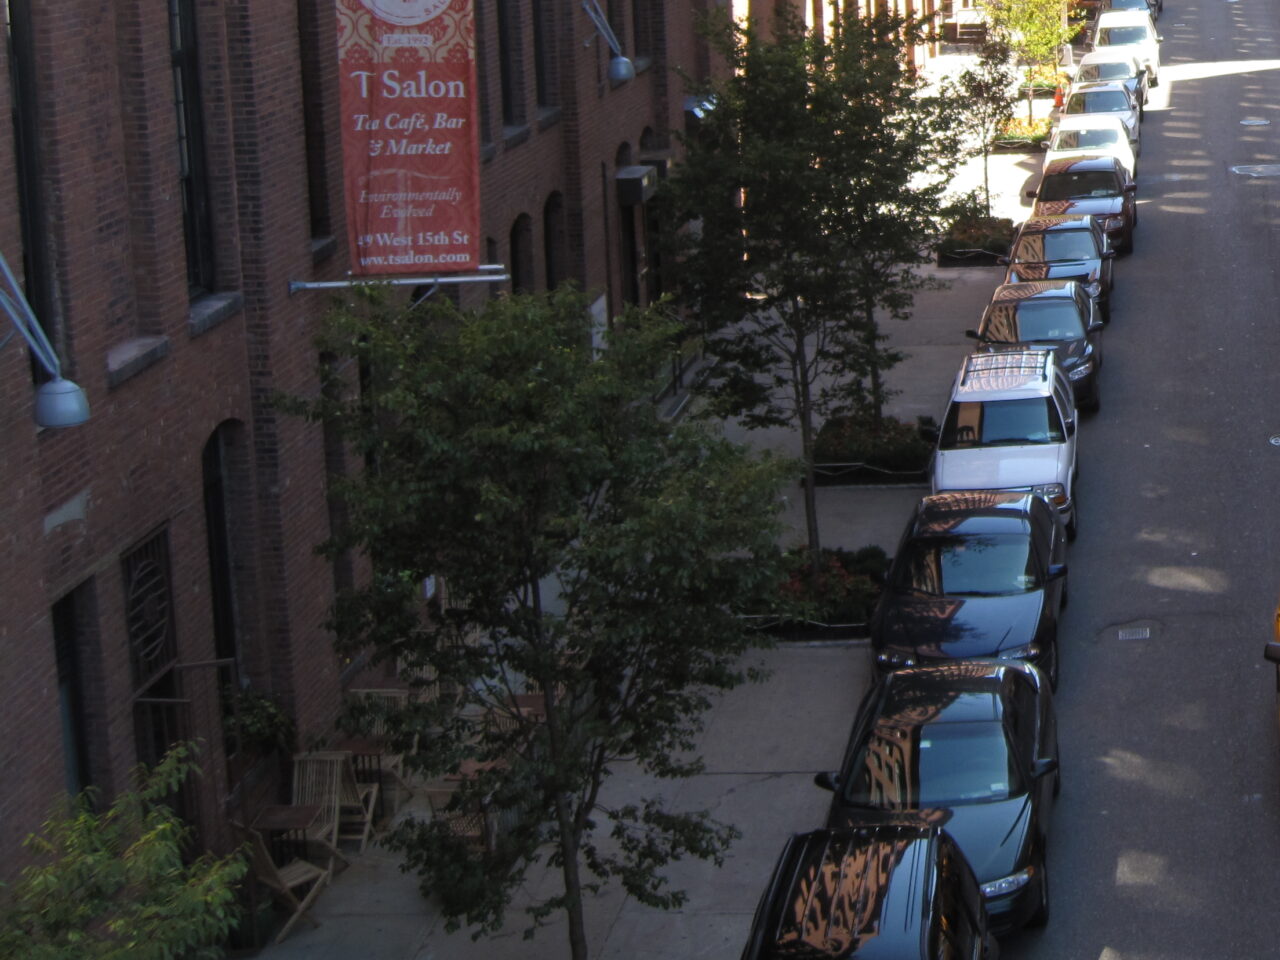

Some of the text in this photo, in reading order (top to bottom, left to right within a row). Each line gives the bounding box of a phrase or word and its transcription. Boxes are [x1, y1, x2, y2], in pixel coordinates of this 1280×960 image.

[349, 70, 466, 98] T Salon
[353, 112, 466, 135] Ta Café, Bar
[385, 138, 453, 155] Market
[359, 187, 462, 205] Environmentally
[380, 204, 436, 218] Evolved
[376, 232, 412, 246] West
[416, 231, 449, 246] 15th
[452, 230, 470, 245] St
